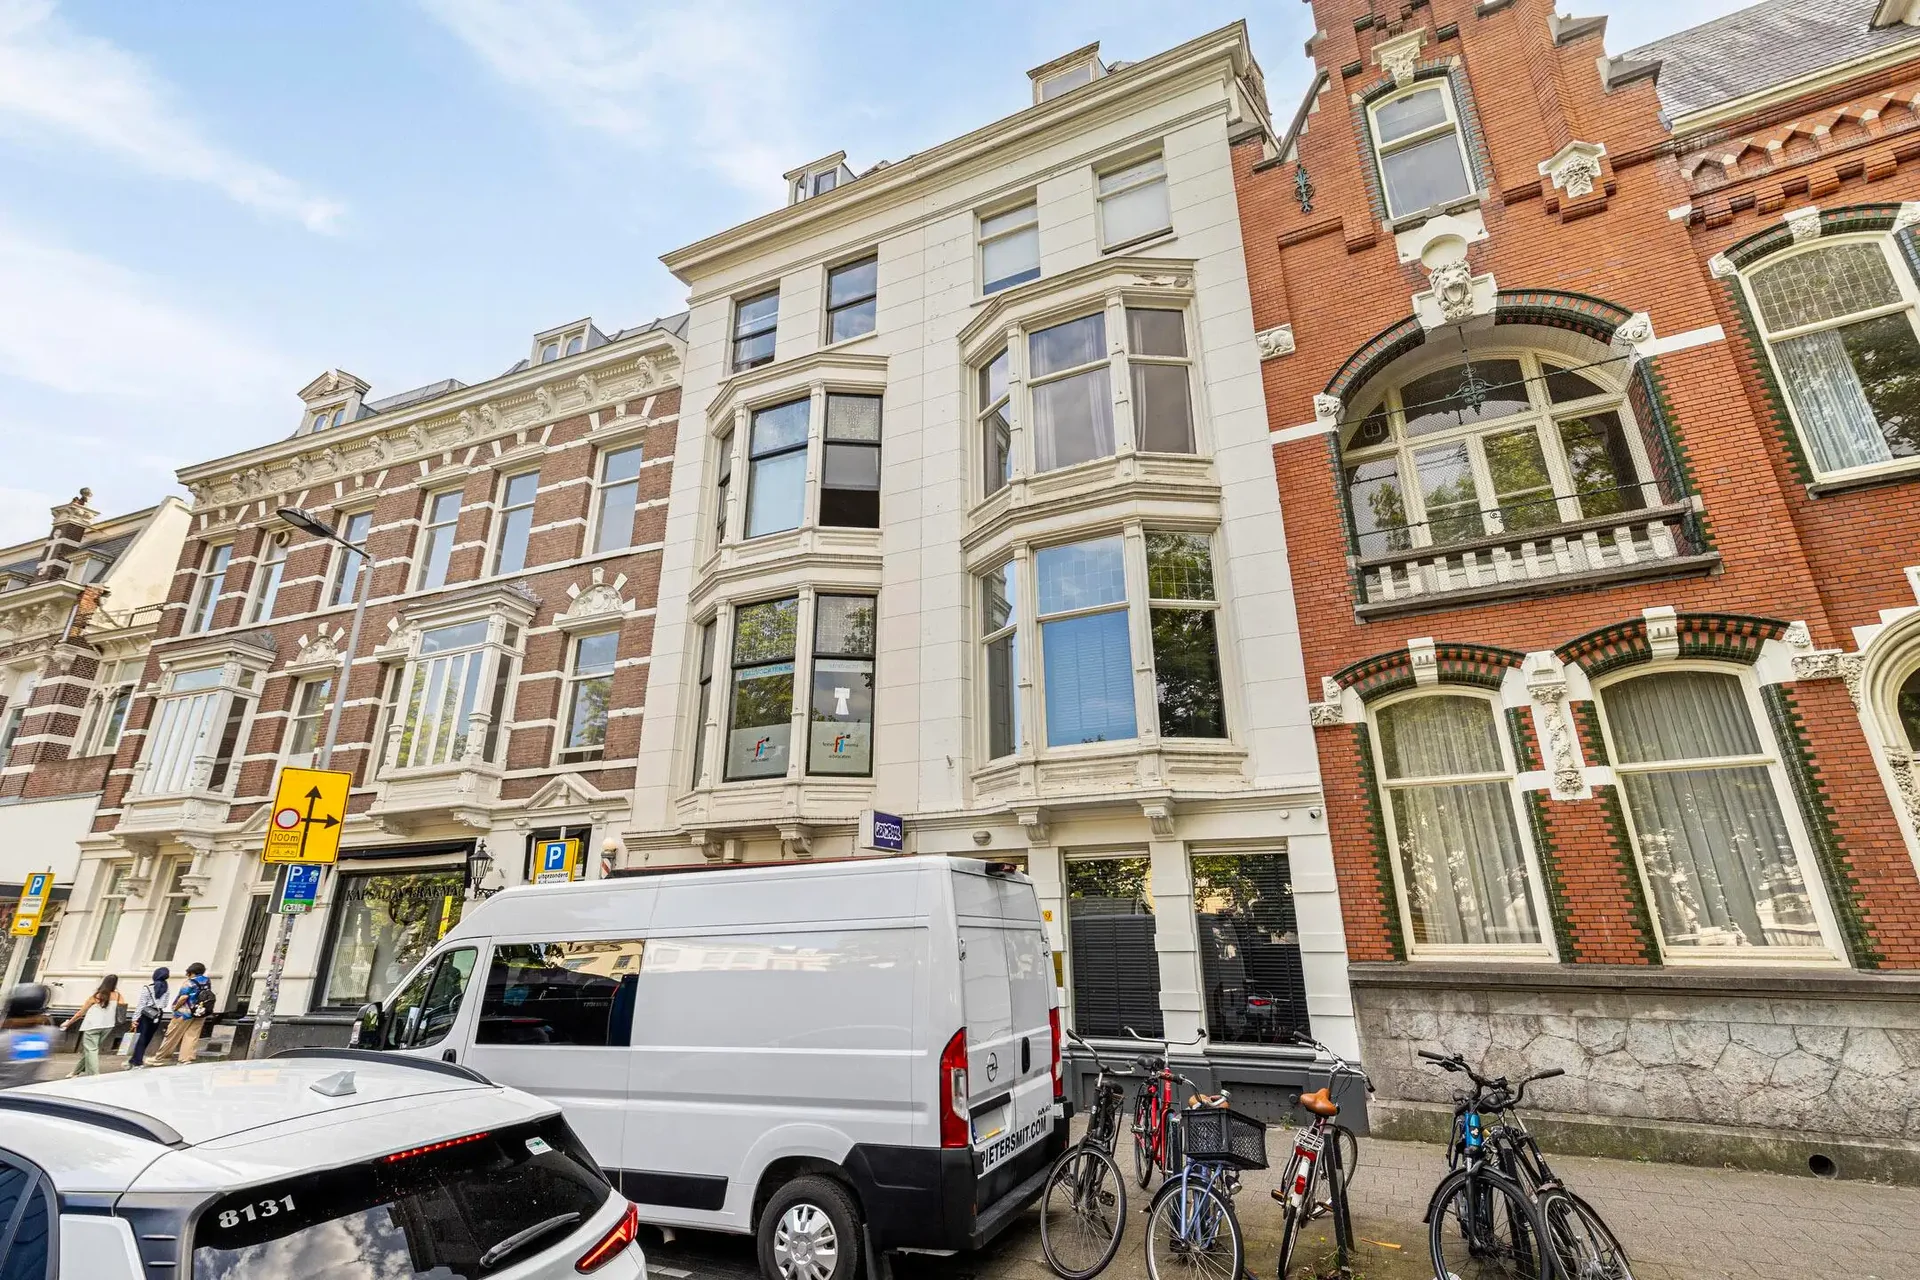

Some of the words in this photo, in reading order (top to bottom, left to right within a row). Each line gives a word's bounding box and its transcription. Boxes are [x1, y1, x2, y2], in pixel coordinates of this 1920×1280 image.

[273, 833, 299, 842] 100m
[549, 846, 562, 868] P
[290, 866, 303, 882] P
[31, 877, 43, 894] P
[346, 887, 404, 901] KAPSALON
[980, 1115, 1047, 1168] PIETERSMIT.COM
[218, 1194, 296, 1228] 8131
